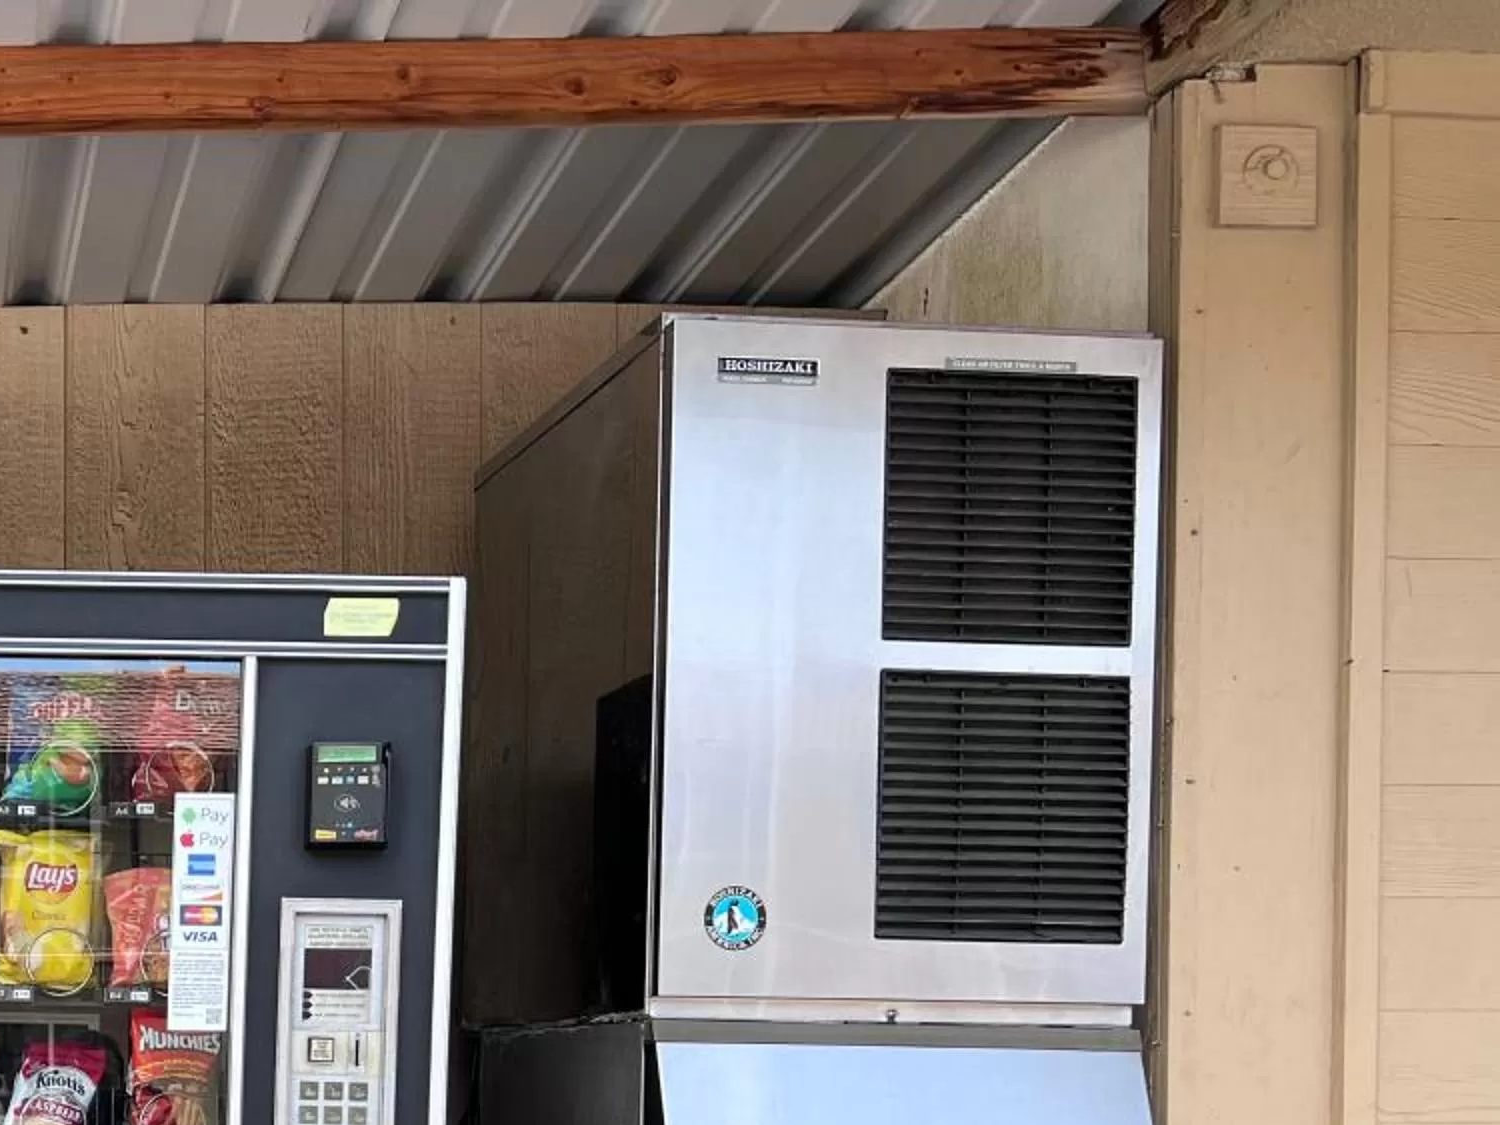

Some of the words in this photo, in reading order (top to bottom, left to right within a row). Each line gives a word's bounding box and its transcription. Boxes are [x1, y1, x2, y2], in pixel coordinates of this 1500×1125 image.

[724, 359, 814, 374] HOSHIZAKI
[201, 807, 229, 826] Pay
[199, 831, 229, 850] Pay
[27, 862, 78, 893] Lay's
[183, 931, 218, 943] VISA
[139, 1024, 221, 1053] MUNCHIES
